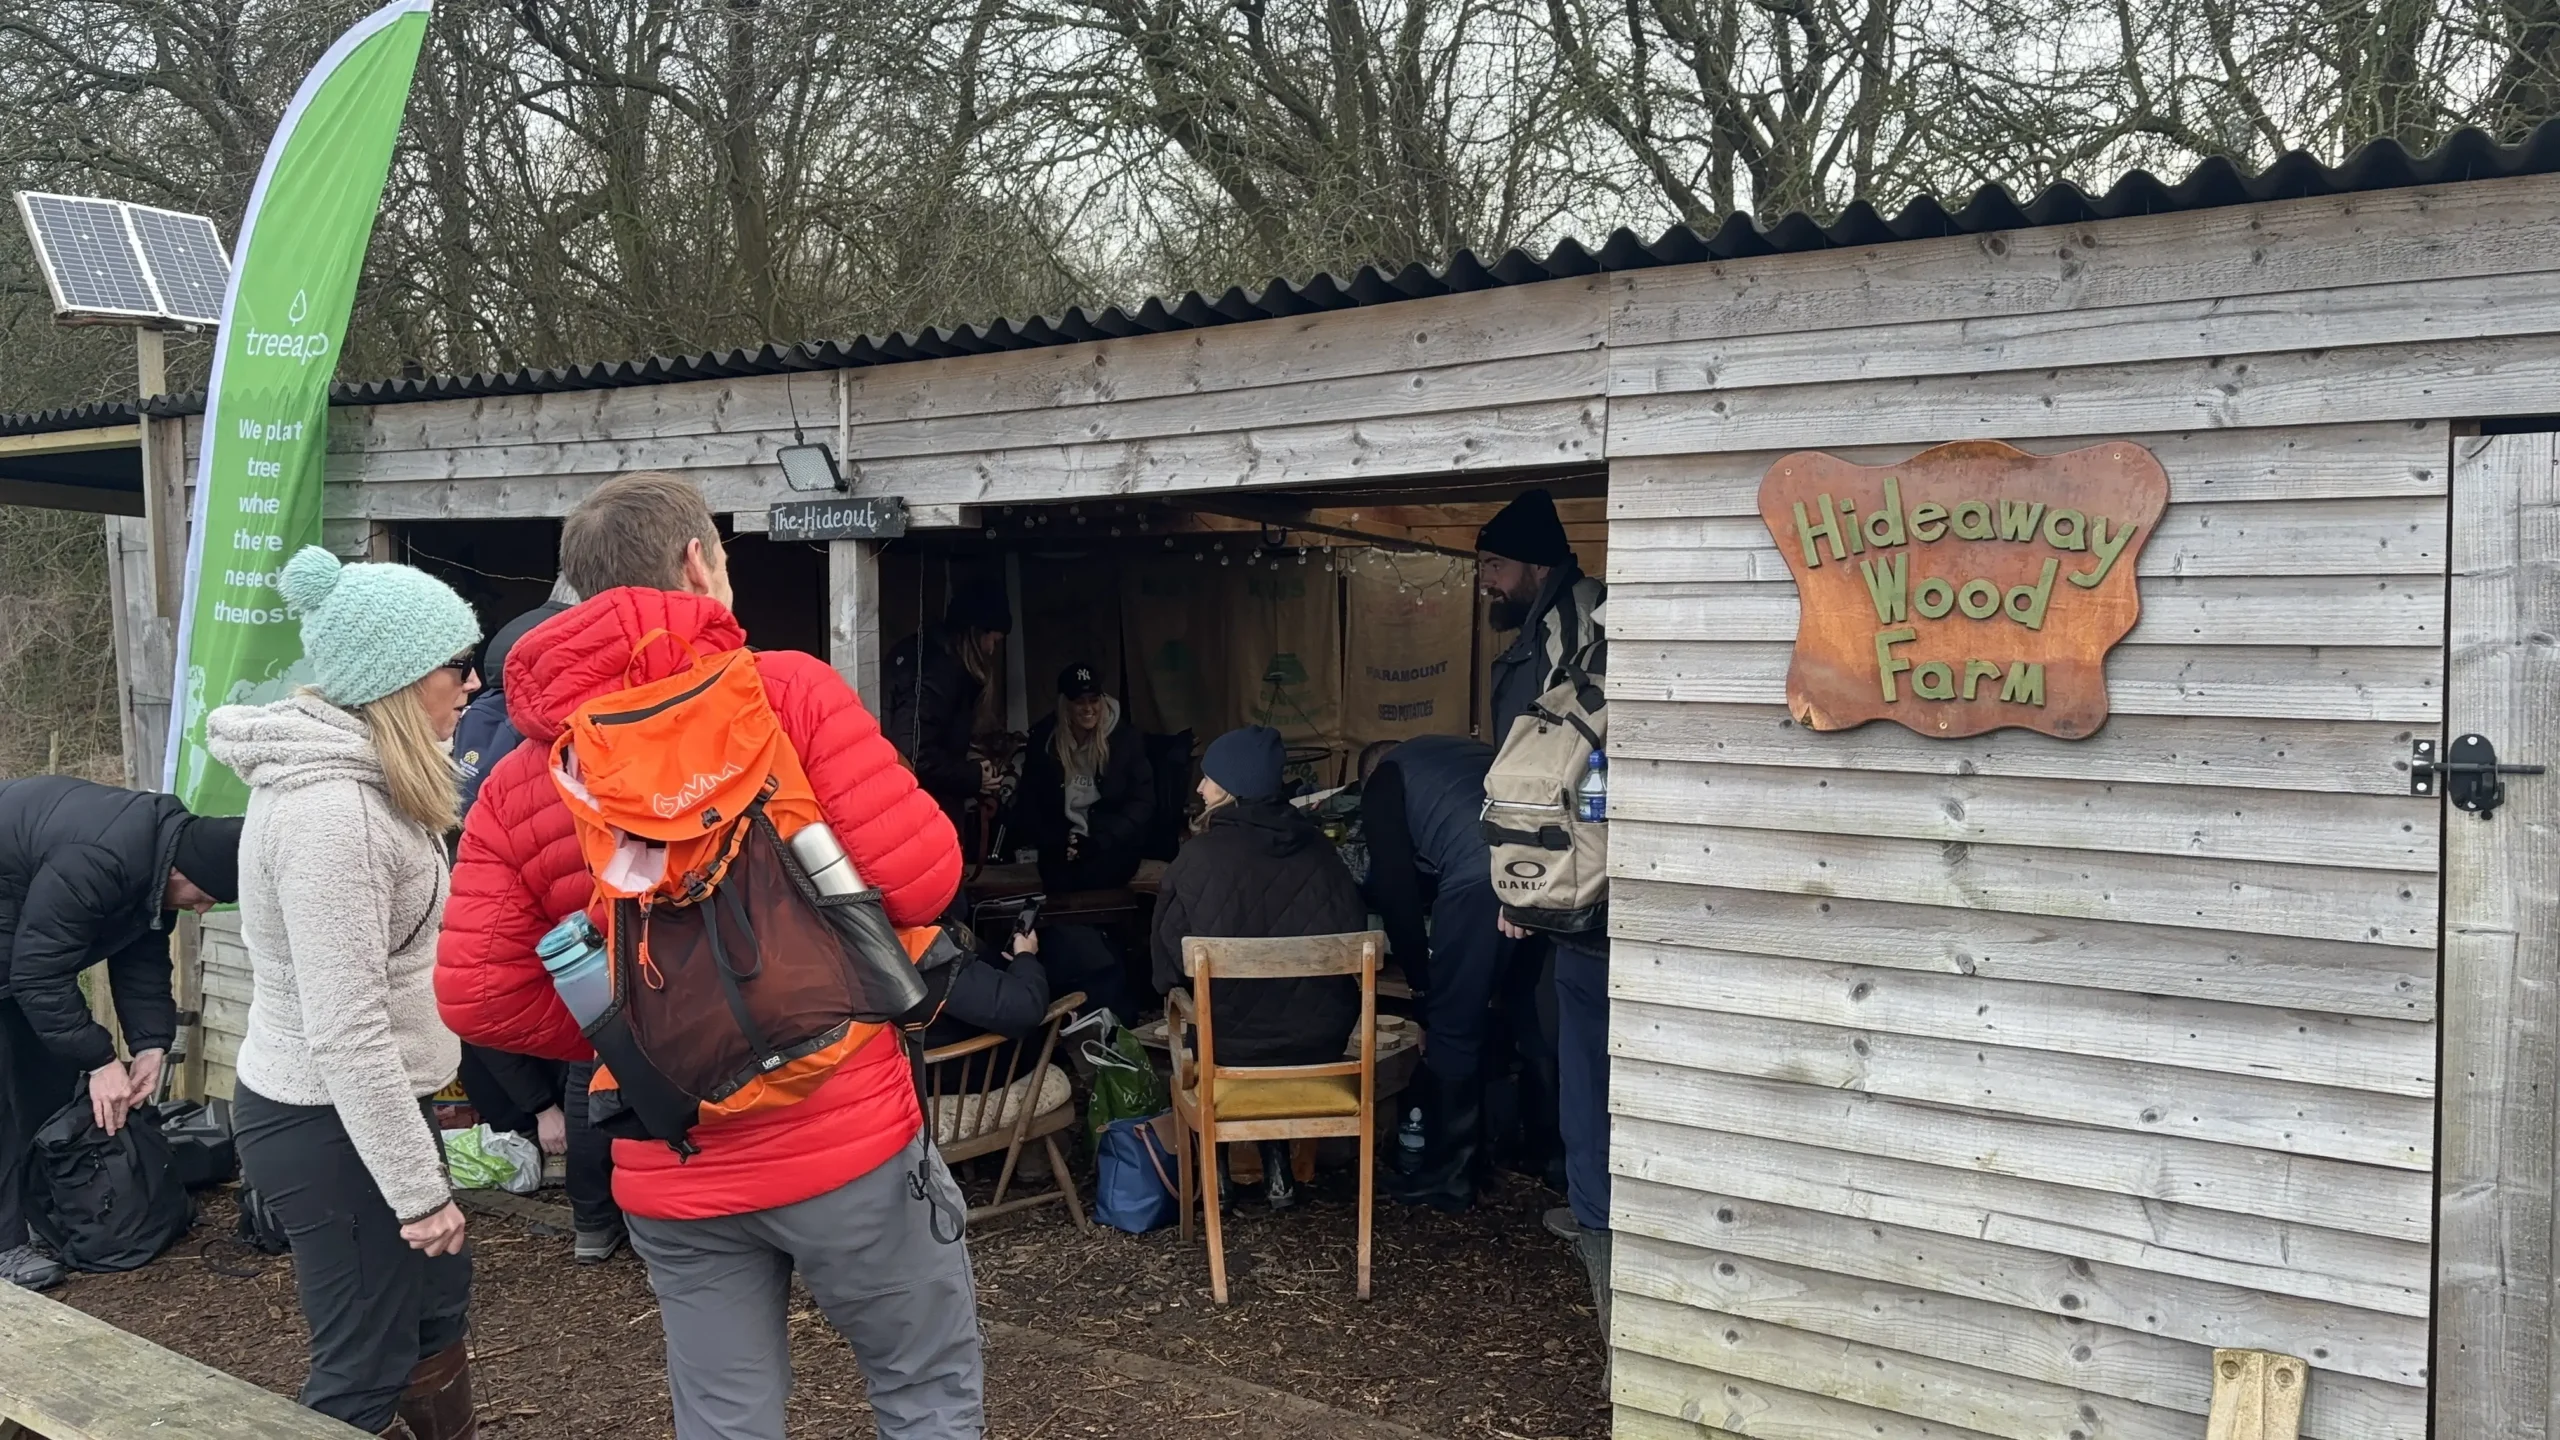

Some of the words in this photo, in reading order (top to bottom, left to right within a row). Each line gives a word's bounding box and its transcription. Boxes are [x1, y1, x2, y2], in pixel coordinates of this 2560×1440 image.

[239, 418, 262, 440] We
[264, 419, 303, 446] plat
[771, 507, 800, 531] The
[800, 502, 877, 531] Hideout
[1793, 476, 2138, 588] Hideaway
[1859, 552, 2060, 630] Wood
[1365, 660, 1448, 682] PARAMOUNT
[1874, 627, 2046, 707] Farm
